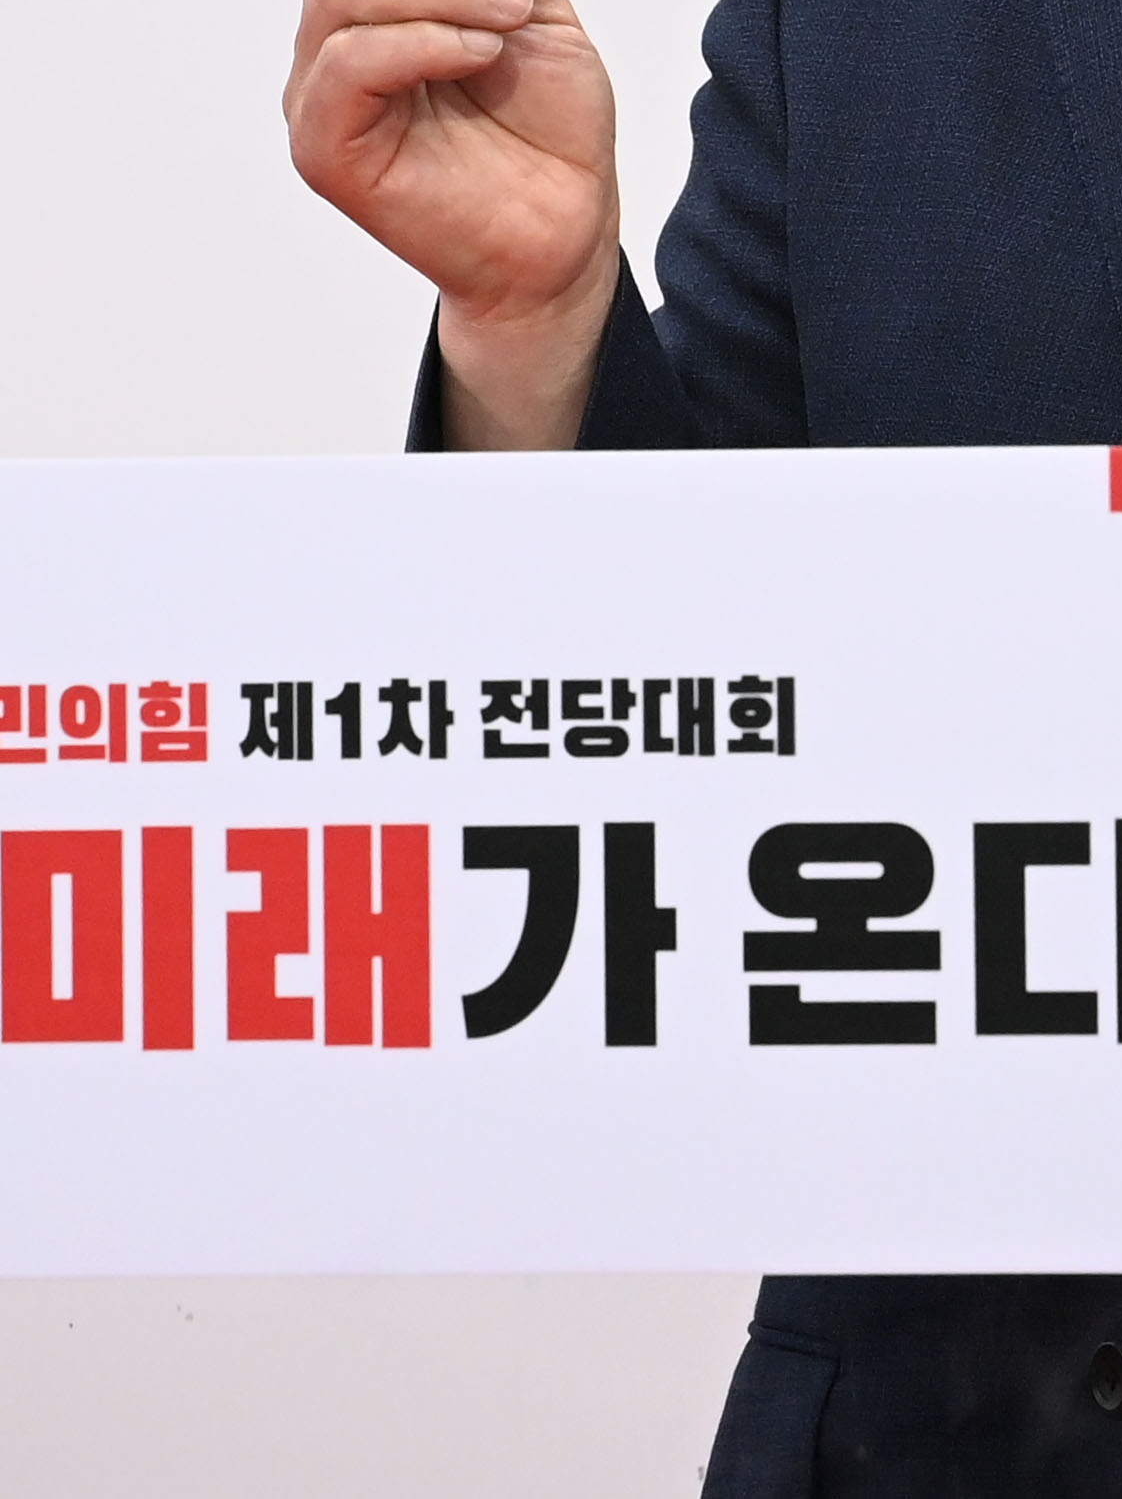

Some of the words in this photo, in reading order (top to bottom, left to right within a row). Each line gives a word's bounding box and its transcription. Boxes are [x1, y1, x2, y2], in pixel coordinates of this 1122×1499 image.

[239, 678, 455, 761] 제1차
[480, 675, 796, 759] 전당대회
[0, 821, 677, 1051] 미래가
